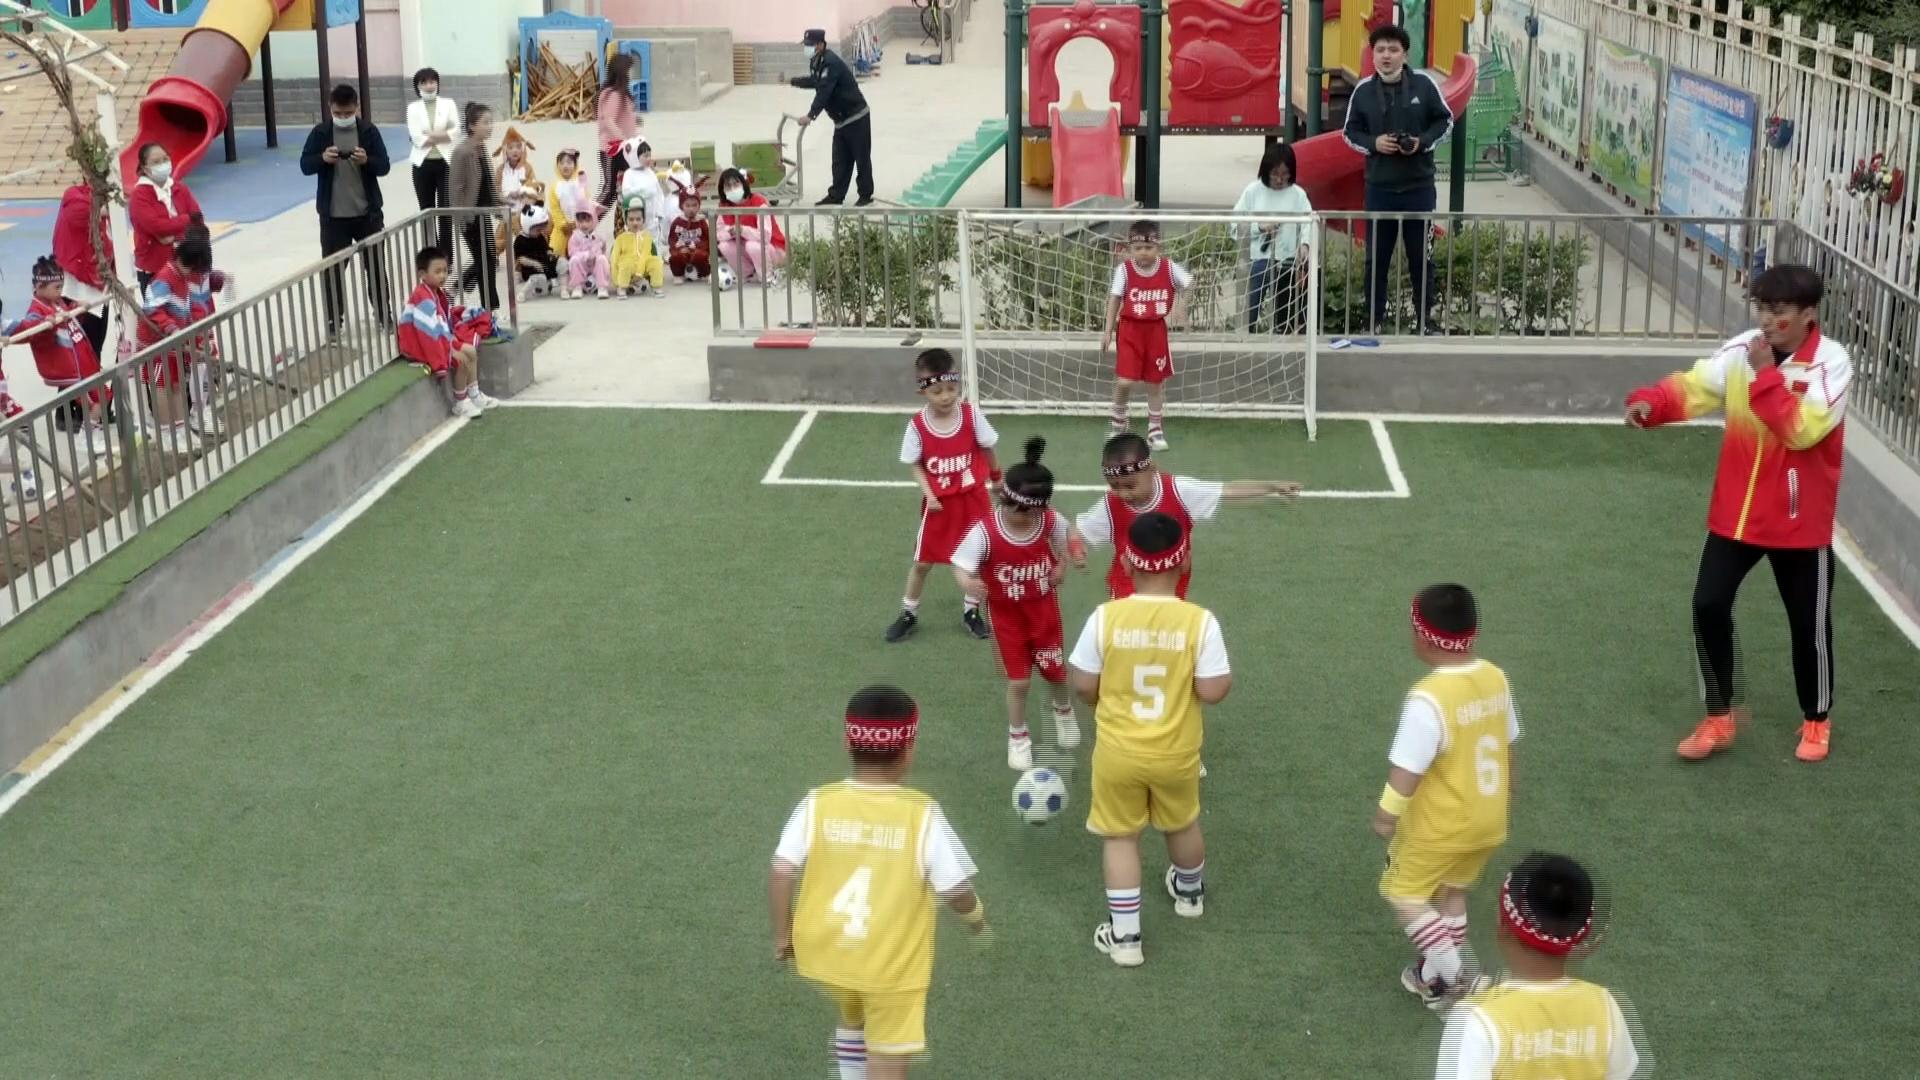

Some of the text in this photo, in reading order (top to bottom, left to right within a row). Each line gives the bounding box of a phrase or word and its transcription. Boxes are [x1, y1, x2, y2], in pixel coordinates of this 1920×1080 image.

[1129, 288, 1170, 303] CHINA
[1131, 665, 1167, 720] 5
[1475, 735, 1500, 796] 6
[831, 865, 873, 940] 4
